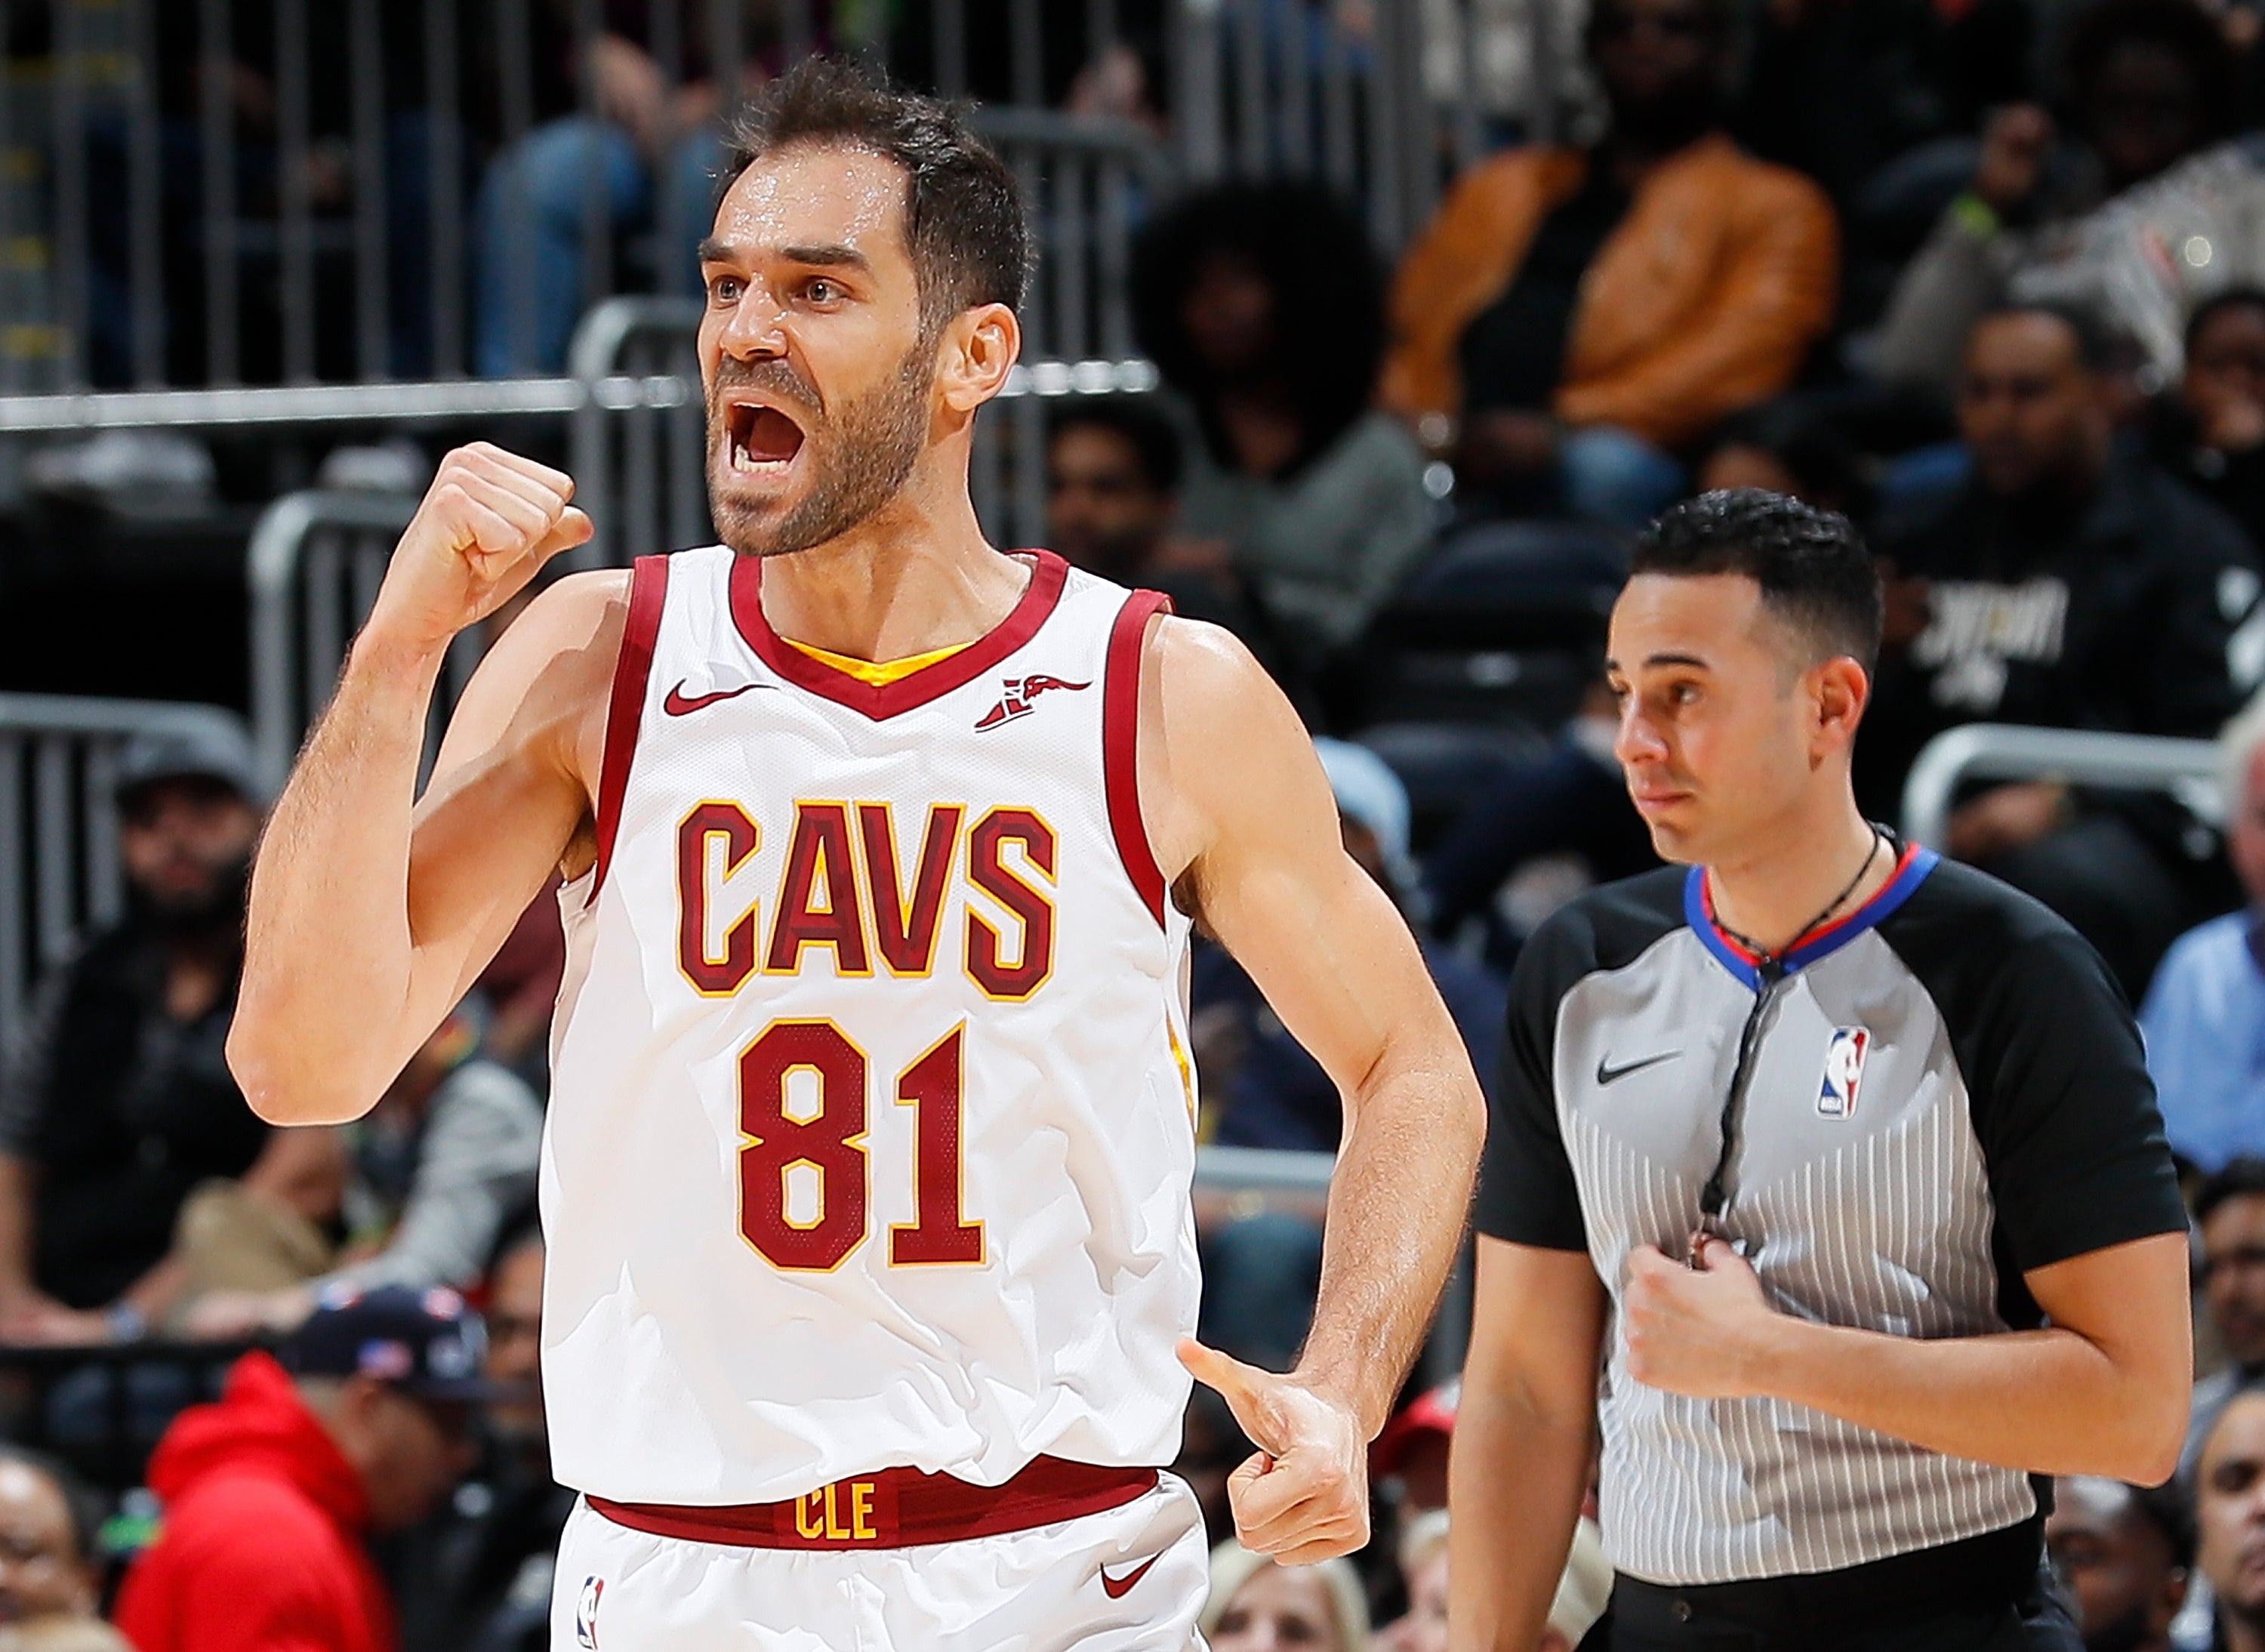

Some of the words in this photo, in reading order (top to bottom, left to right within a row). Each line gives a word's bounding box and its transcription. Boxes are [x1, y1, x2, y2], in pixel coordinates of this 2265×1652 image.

[676, 799, 1059, 1002] CAVS
[737, 1017, 986, 1273] 81
[796, 1483, 877, 1540] CLE
